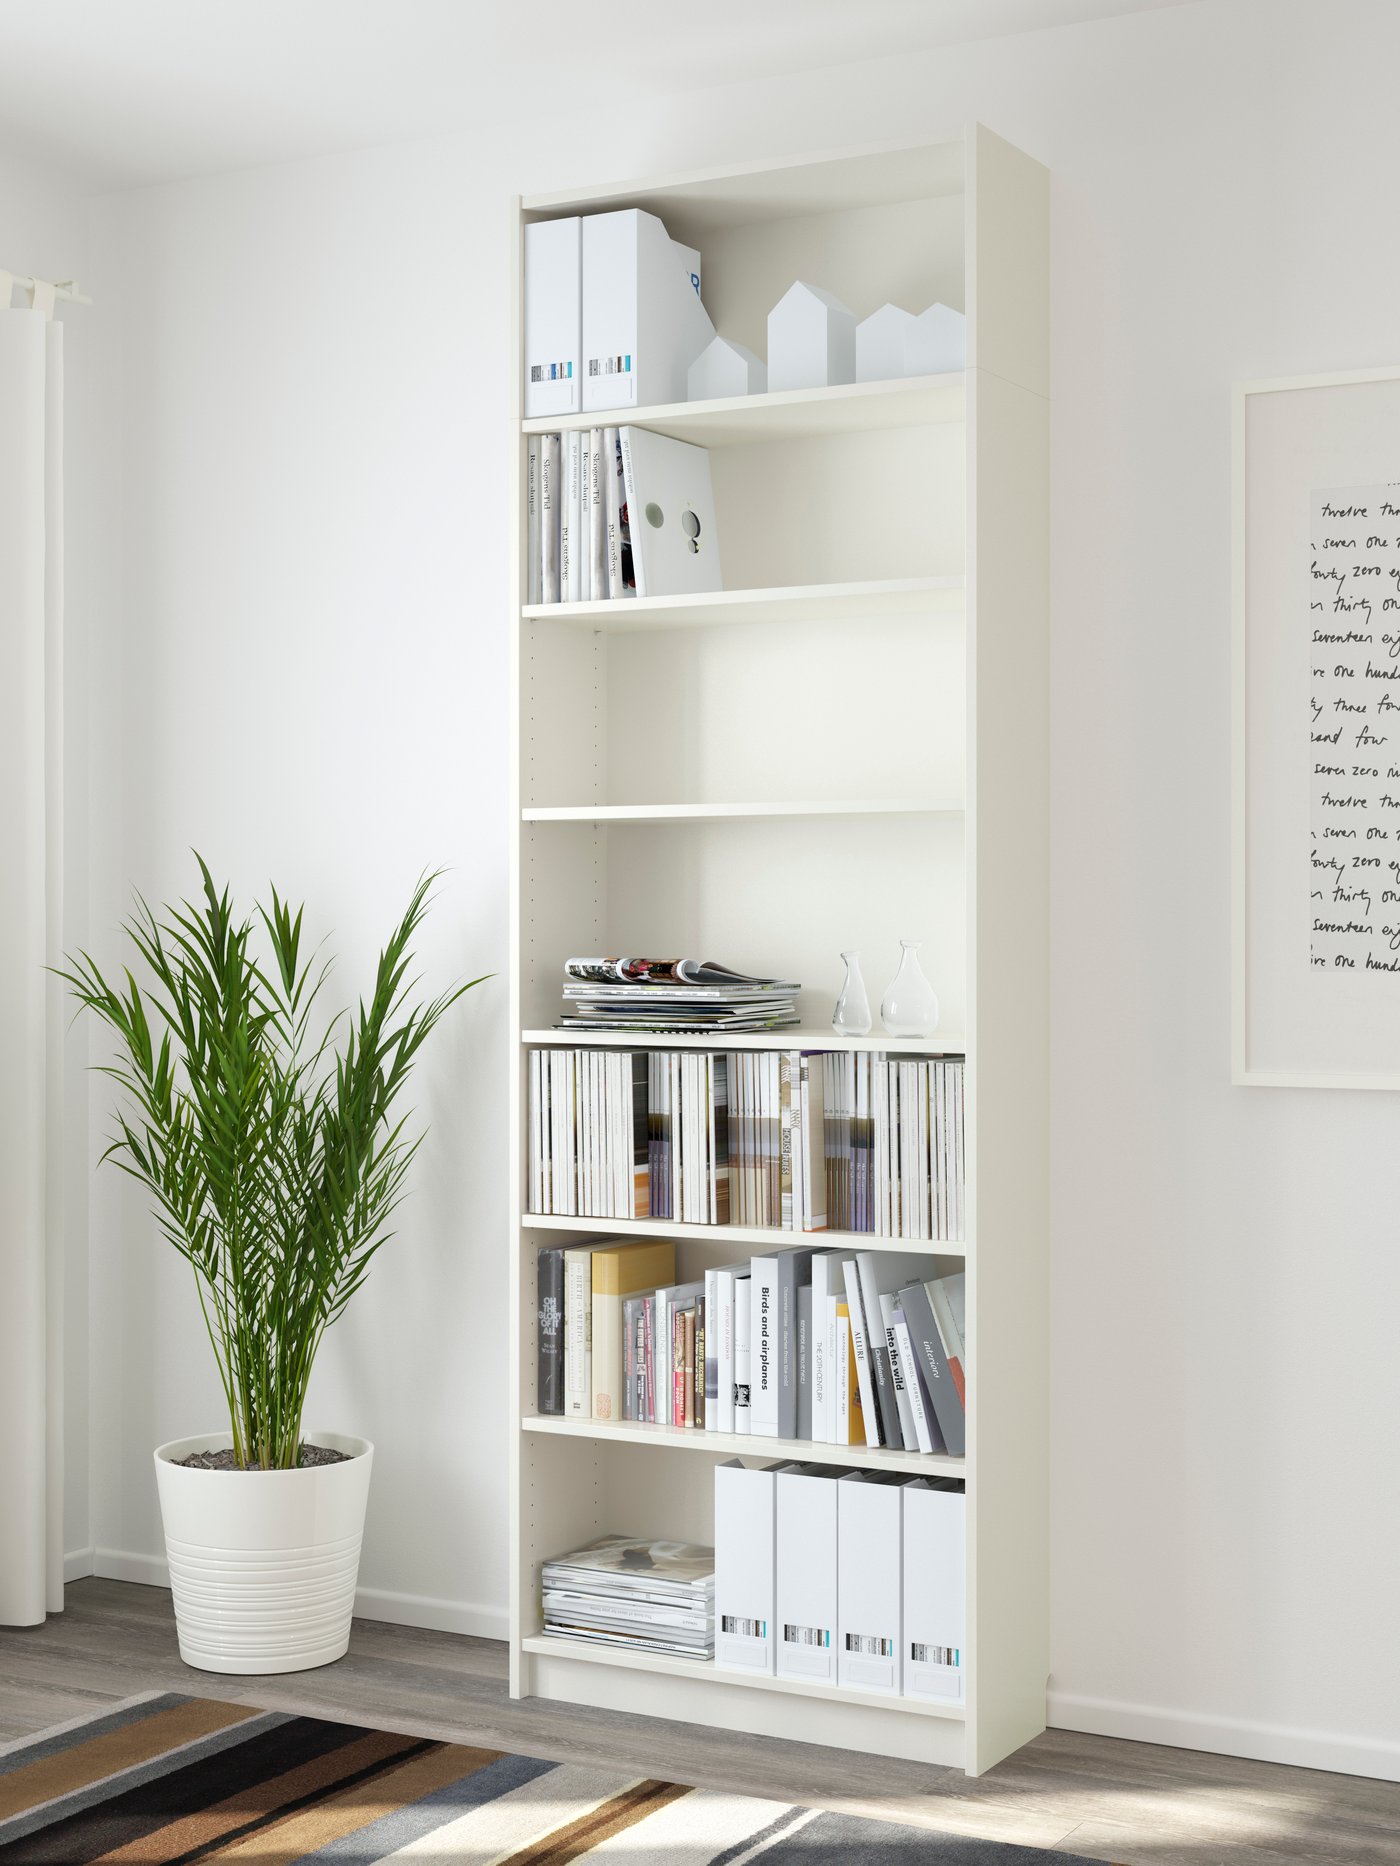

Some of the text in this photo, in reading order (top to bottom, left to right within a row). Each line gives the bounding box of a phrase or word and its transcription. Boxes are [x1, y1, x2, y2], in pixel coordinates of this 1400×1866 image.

[543, 459, 551, 510] Skogens Tid
[592, 453, 600, 505] Skogens Tid
[1321, 502, 1368, 518] twelve
[1322, 538, 1357, 549] seven
[1365, 535, 1389, 549] one
[609, 541, 617, 577] Skogens
[1352, 565, 1382, 578] zero
[1332, 595, 1372, 625] thirty
[1333, 664, 1355, 678] one
[1333, 697, 1367, 714] three
[1313, 763, 1346, 776] seven
[1351, 766, 1379, 777] zero
[1321, 791, 1368, 809] twelve
[1322, 827, 1357, 839] seven
[1366, 827, 1389, 840] one
[1351, 856, 1381, 868] zero
[1332, 885, 1371, 916] thirty
[1381, 890, 1400, 903] on
[1334, 954, 1356, 968] one
[782, 1128, 791, 1153] HOUSE
[543, 1297, 557, 1305] OH
[543, 1304, 557, 1312] THE
[538, 1312, 562, 1320] GLORY
[540, 1319, 552, 1328] OF
[543, 1327, 557, 1336] ALL
[759, 1287, 770, 1391] Birds and airplanes
[854, 1330, 865, 1361] ALLURE
[886, 1327, 904, 1391] into the wild
[923, 1341, 940, 1378] interiors
[874, 1349, 886, 1387] Christianity
[905, 1354, 915, 1378] SCHOOL
[912, 1383, 924, 1420] FURNITURE
